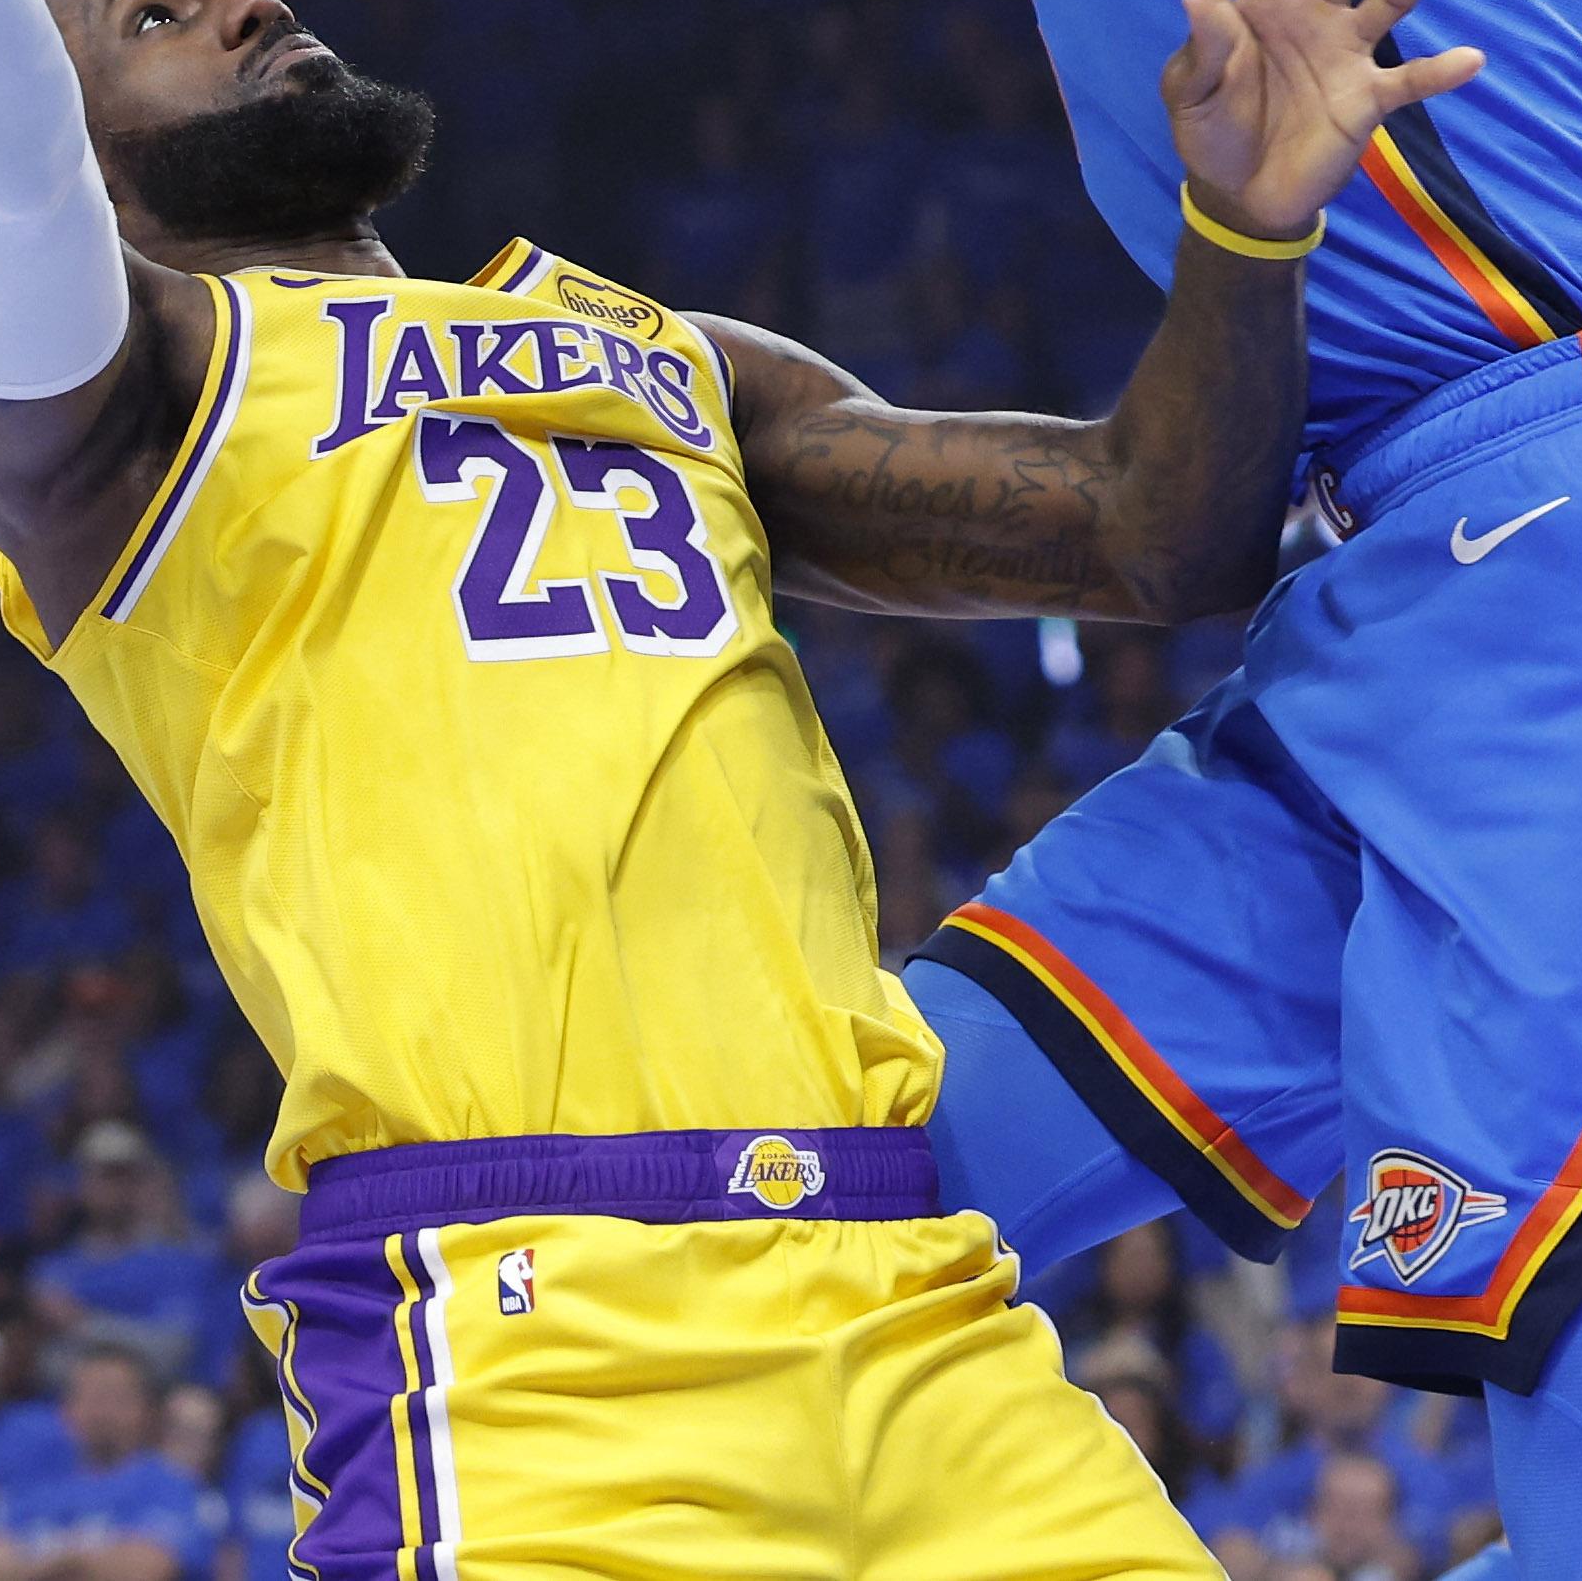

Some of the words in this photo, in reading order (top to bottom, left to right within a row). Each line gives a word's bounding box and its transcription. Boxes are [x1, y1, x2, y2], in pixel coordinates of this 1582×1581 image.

[562, 287, 651, 329] bibigo
[309, 294, 715, 461] LAKERS
[412, 409, 740, 662] 23
[732, 1153, 820, 1191] LAKERS
[1365, 1184, 1440, 1248] OKC
[502, 1295, 523, 1313] NBA
